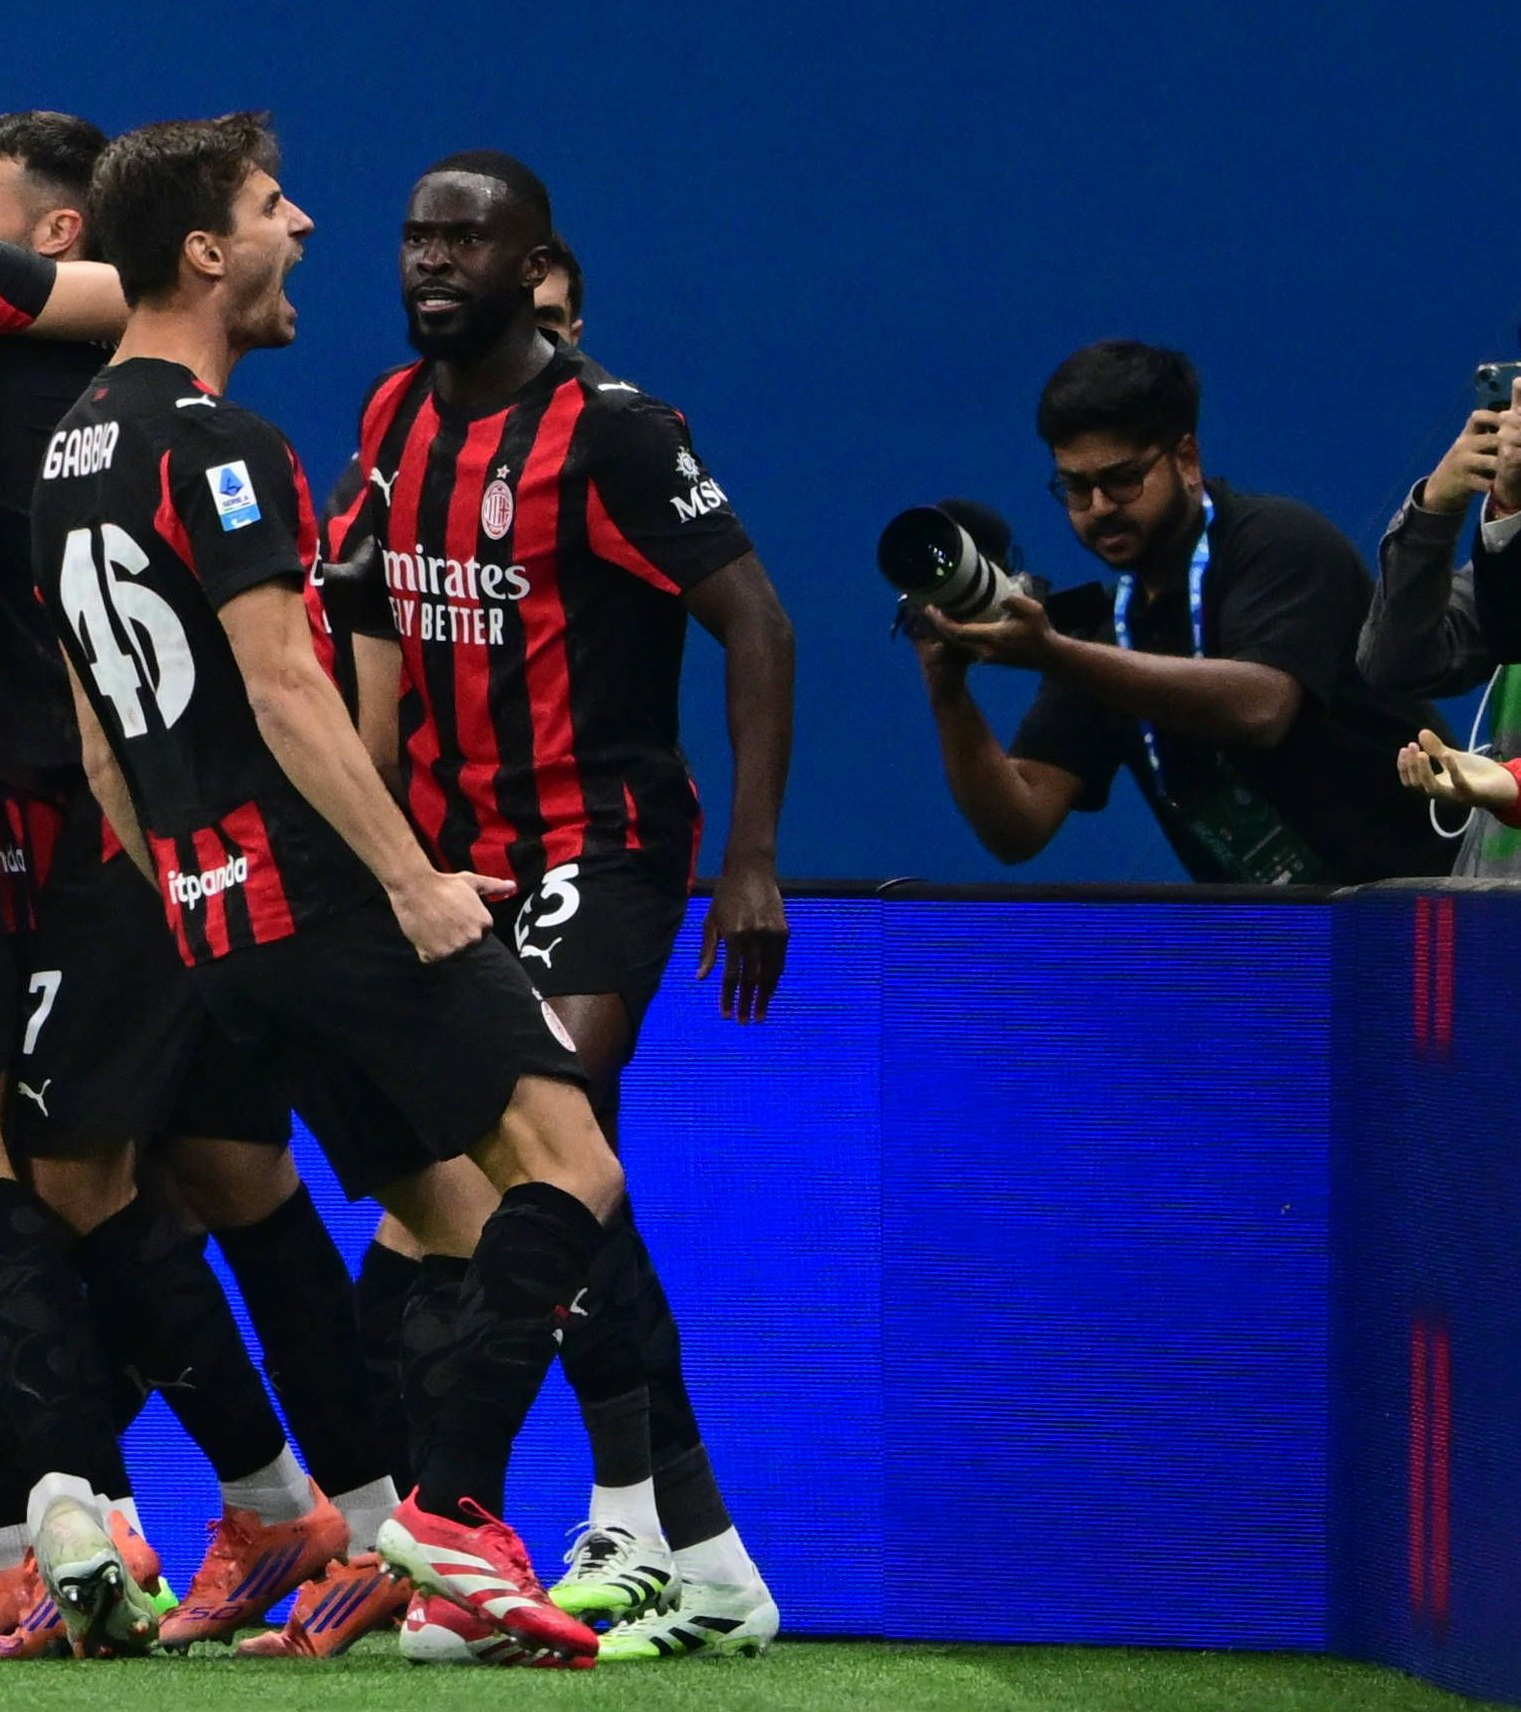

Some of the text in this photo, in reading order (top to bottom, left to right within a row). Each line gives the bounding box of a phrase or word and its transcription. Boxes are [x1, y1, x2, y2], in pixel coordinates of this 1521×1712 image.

[43, 421, 119, 479] GABBIA
[377, 538, 530, 600] mirates
[60, 523, 195, 738] 46
[421, 603, 503, 645] BETTER
[23, 970, 62, 1054] 7
